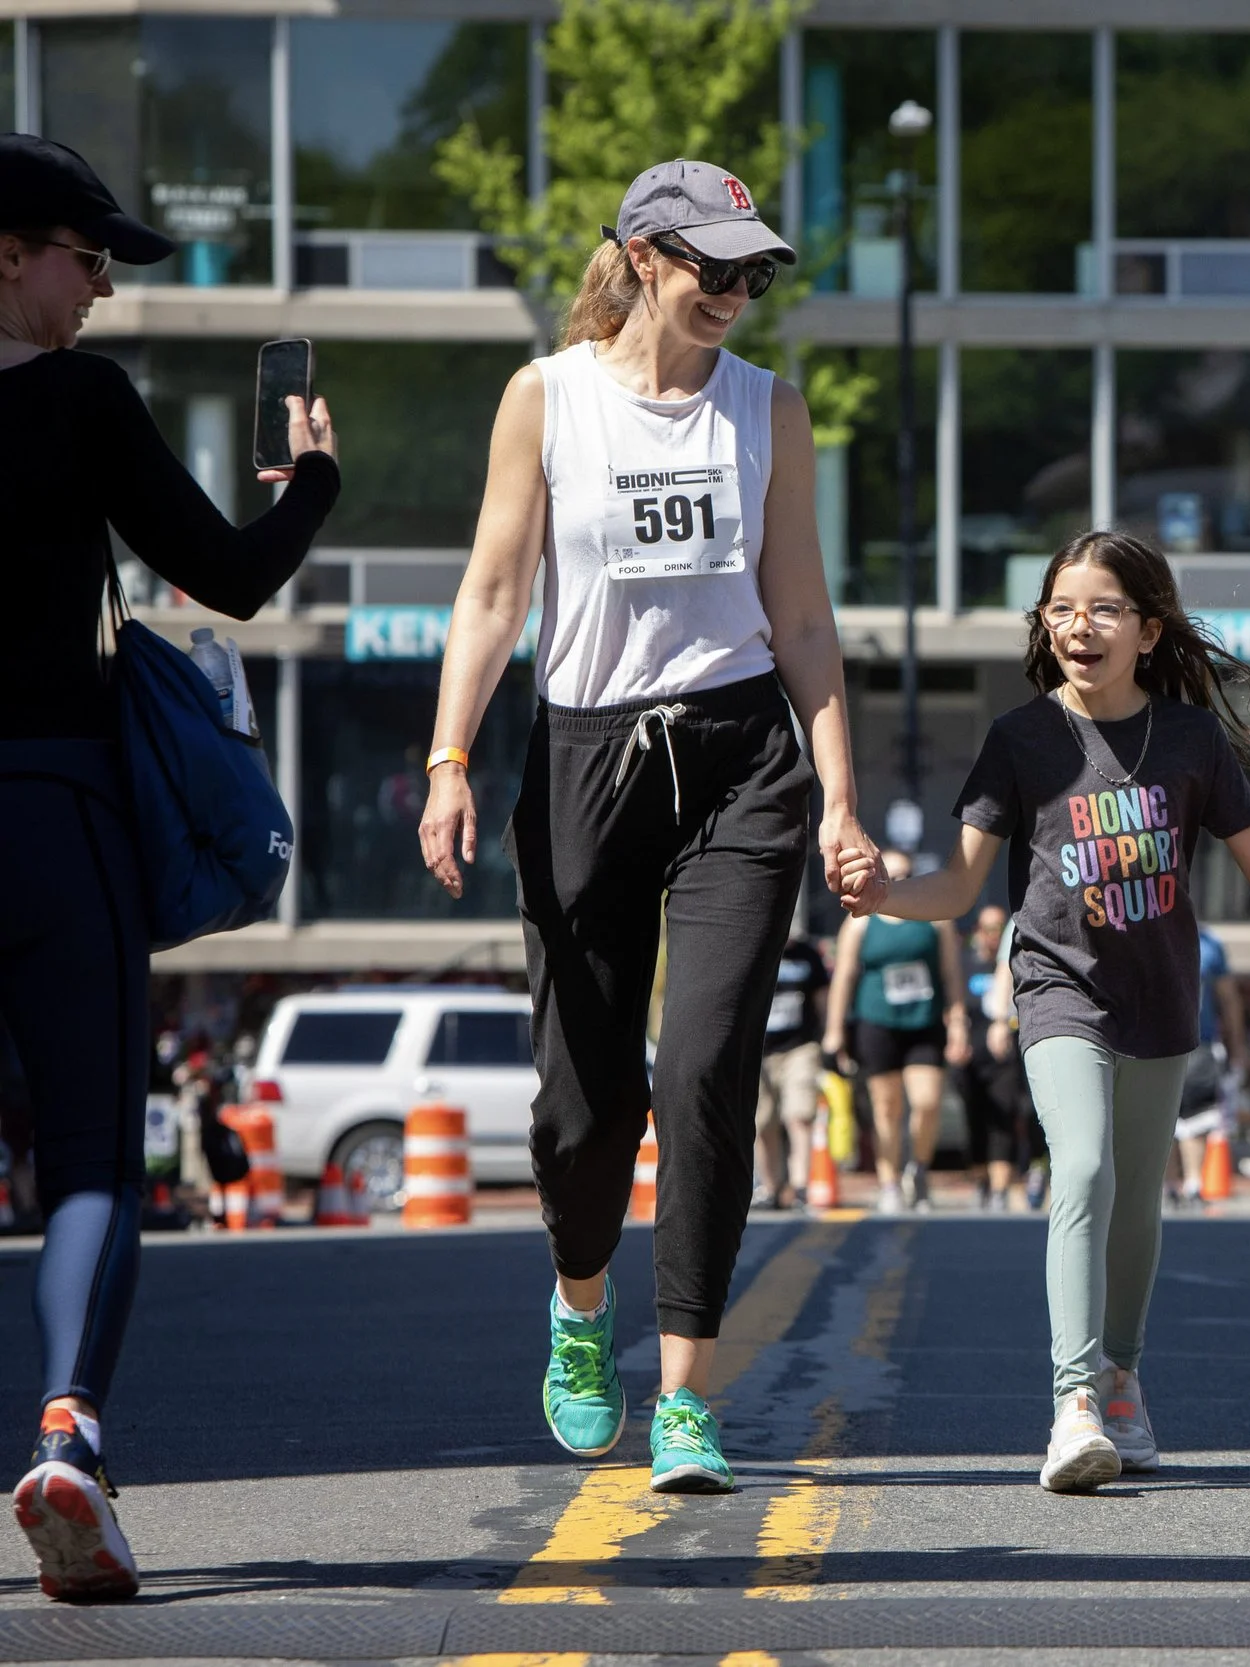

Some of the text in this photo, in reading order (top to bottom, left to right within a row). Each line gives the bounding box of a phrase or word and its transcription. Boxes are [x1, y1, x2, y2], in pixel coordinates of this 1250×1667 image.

[721, 177, 749, 210] B
[615, 469, 708, 490] BIONIC
[633, 493, 715, 544] 591
[619, 560, 736, 574] FOOD DRINK DRINK
[1068, 785, 1168, 839] BIONIC
[1060, 827, 1179, 887] SUPPORT
[1084, 874, 1176, 932] SQUAD
